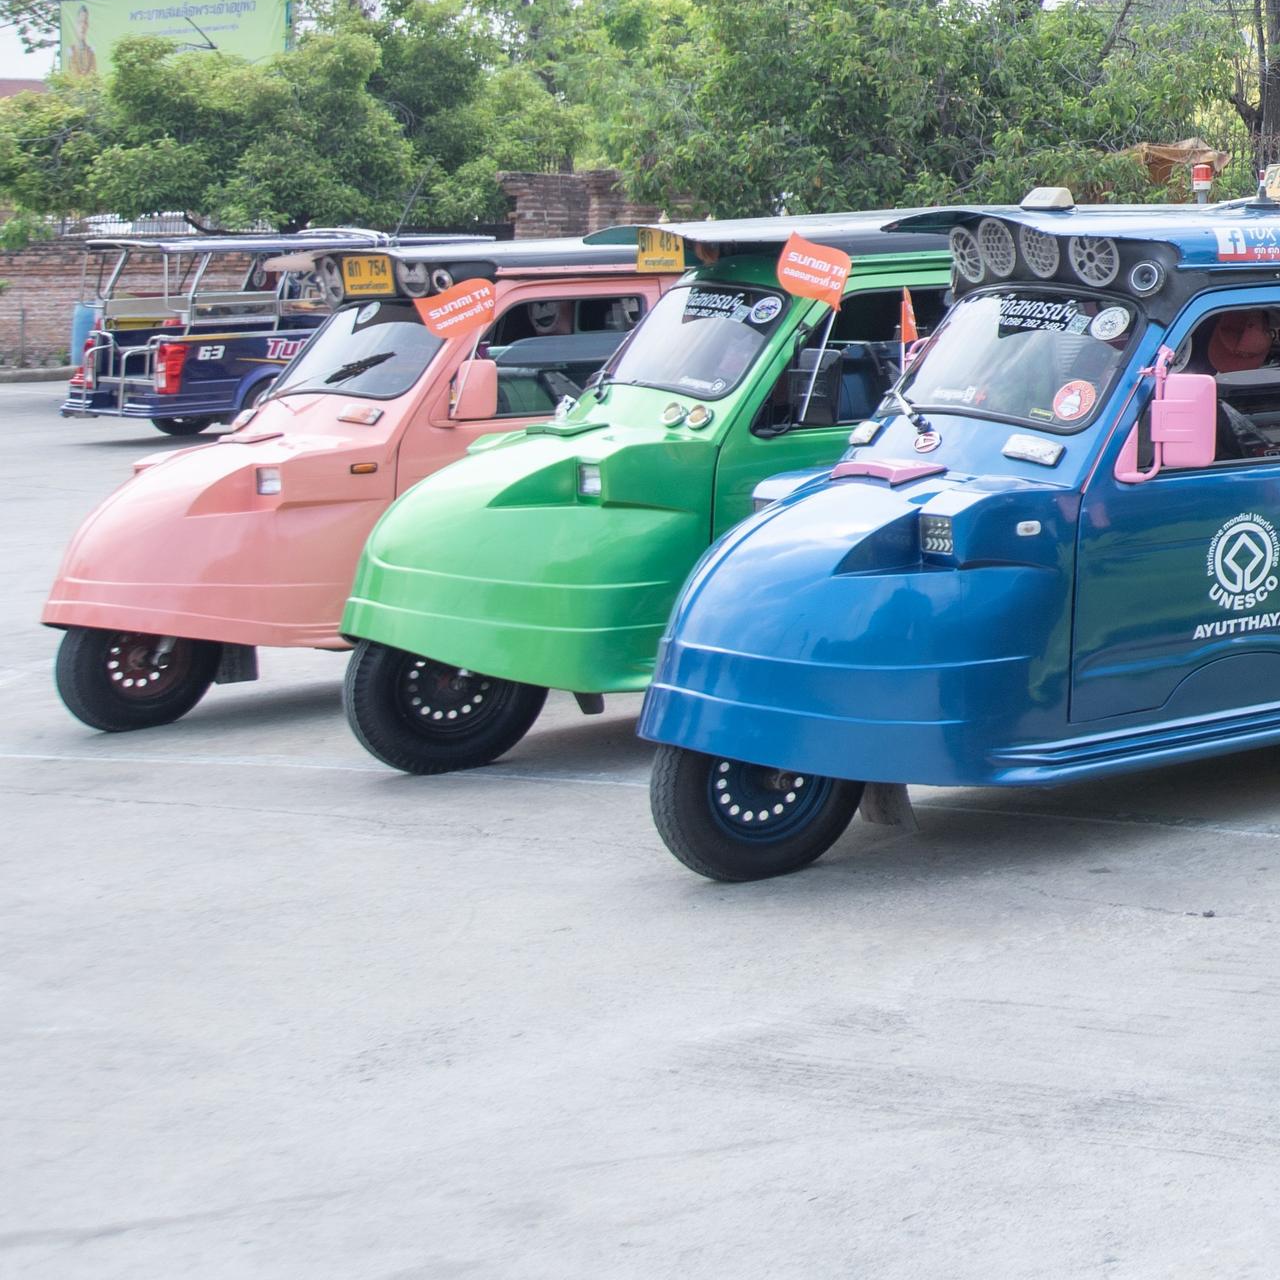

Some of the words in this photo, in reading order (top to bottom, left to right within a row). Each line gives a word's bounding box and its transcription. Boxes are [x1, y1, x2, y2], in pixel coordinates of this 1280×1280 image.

[788, 251, 830, 272] SUNMI
[831, 264, 847, 278] TH
[428, 296, 472, 319] SUNMI
[473, 287, 491, 301] TH
[197, 345, 226, 361] 63
[1206, 528, 1224, 577] Patrimoine
[1223, 513, 1252, 529] mondial
[1253, 513, 1273, 531] World
[1269, 529, 1280, 567] Heritage
[1209, 575, 1279, 610] UNESCO
